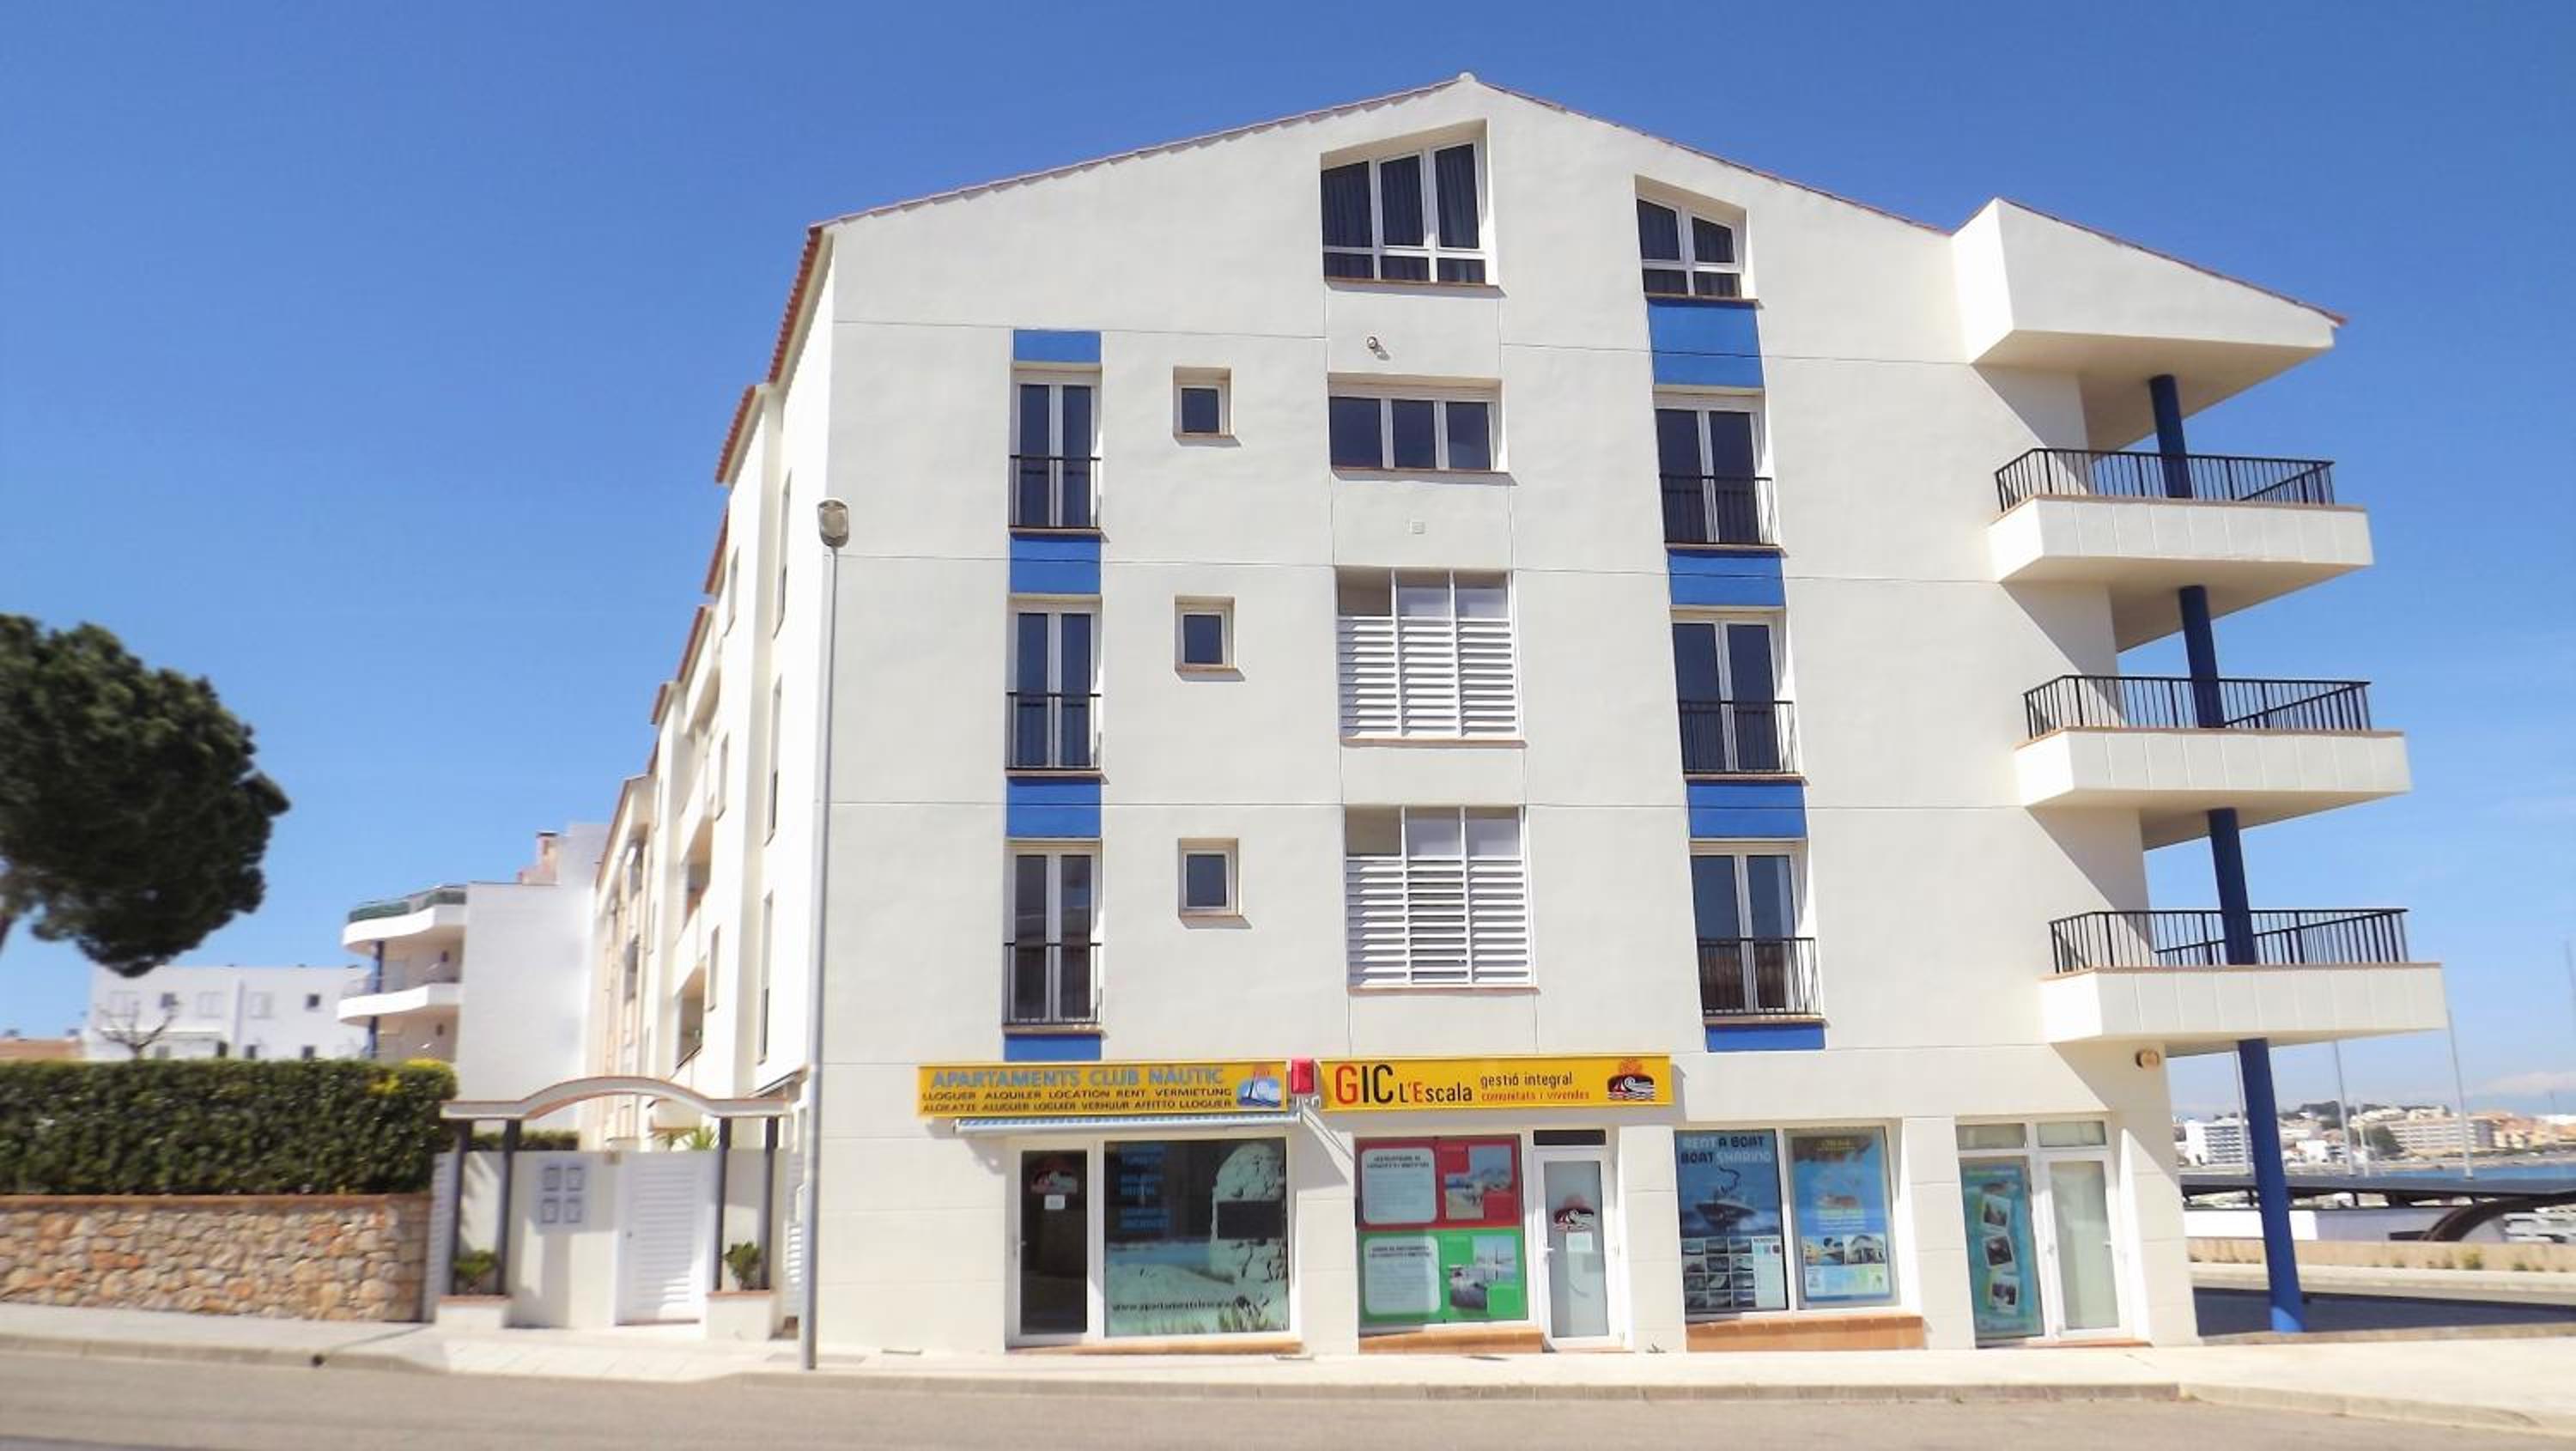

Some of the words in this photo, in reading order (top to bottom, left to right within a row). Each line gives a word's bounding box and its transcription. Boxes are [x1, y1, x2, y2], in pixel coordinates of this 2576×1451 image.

[933, 1070, 1080, 1088] APARTAMENTS
[1089, 1070, 1139, 1086] CLUB
[1335, 1064, 1394, 1104] GIC
[1480, 1073, 1519, 1089] gestió
[1524, 1072, 1573, 1089] integral
[923, 1091, 976, 1100] LLOGUER
[985, 1090, 1042, 1100] ALQUILER
[1048, 1090, 1110, 1099] LOCATION
[1116, 1089, 1146, 1098] RENT
[1155, 1088, 1231, 1097] VERMIETUNG
[1399, 1081, 1473, 1103] L'Escala
[1731, 1135, 1765, 1148] BOAT
[1680, 1151, 1714, 1163] BOAT
